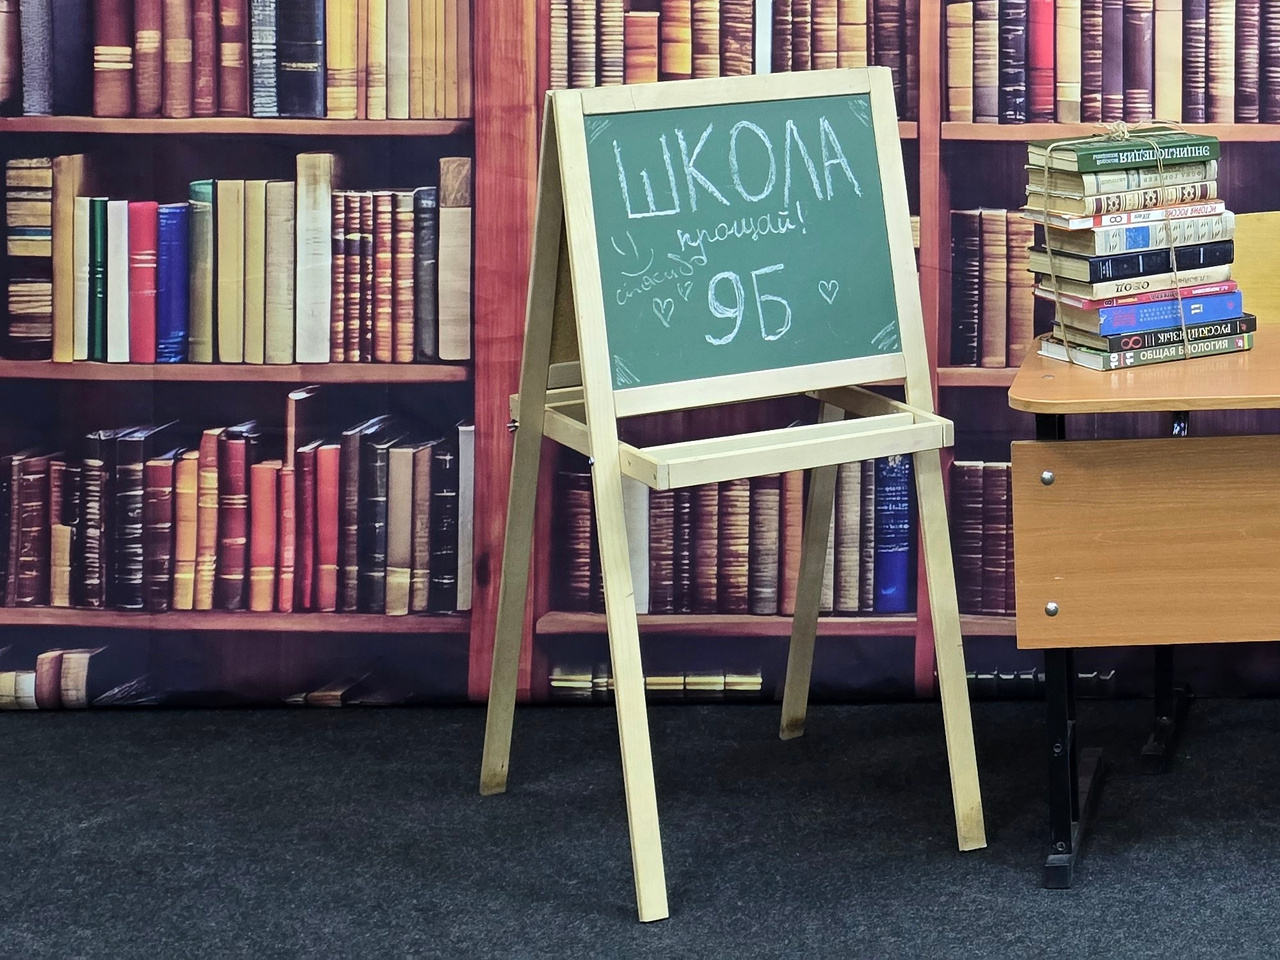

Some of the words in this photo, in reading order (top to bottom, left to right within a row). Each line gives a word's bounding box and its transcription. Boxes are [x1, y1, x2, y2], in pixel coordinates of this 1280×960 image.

[1119, 145, 1210, 163] ЭНЦИКЛОПЕДИЯ
[612, 116, 862, 219] ШКОЛА
[1143, 172, 1178, 183] ГОРЕЕВ
[1191, 206, 1217, 217] ИСТОРИЯ
[677, 201, 807, 266] прощай!
[705, 263, 791, 345] 9Б
[1187, 323, 1231, 340] РУССКИЙ
[1110, 352, 1119, 369] 10
[1125, 352, 1134, 366] 11
[1140, 347, 1175, 360] ОБЩАЯ
